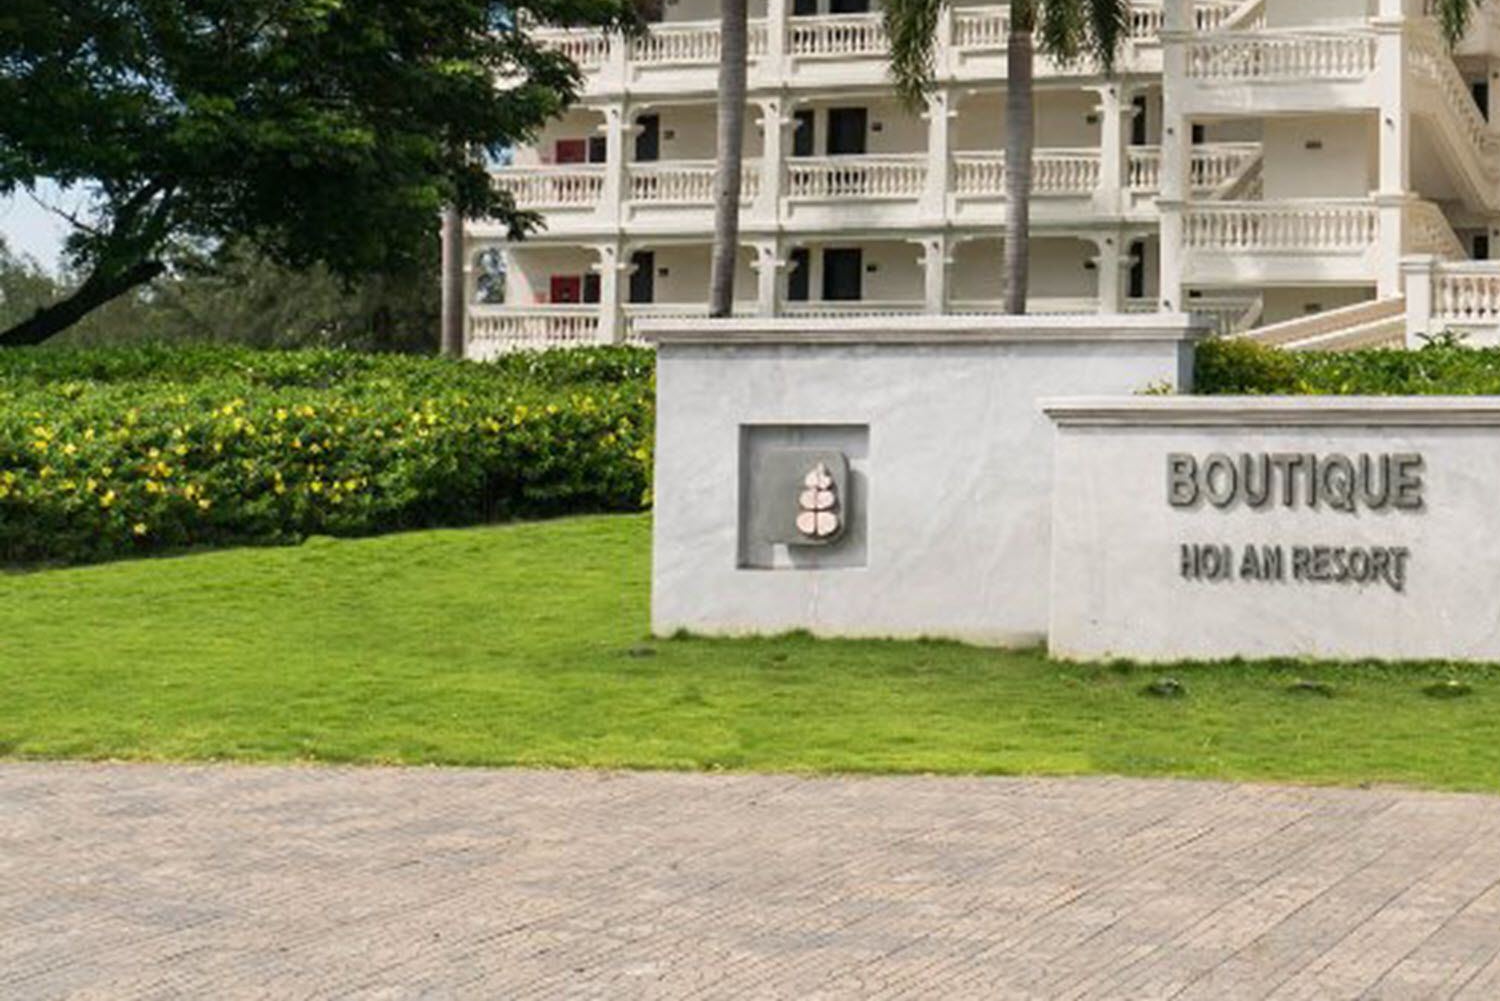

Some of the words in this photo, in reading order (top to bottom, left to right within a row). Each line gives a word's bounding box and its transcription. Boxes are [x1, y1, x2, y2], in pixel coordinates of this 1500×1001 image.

[1167, 453, 1426, 514] BOUTIQUE
[1180, 543, 1232, 580] HOI
[1240, 544, 1283, 581] AN
[1291, 545, 1410, 593] RESORT
